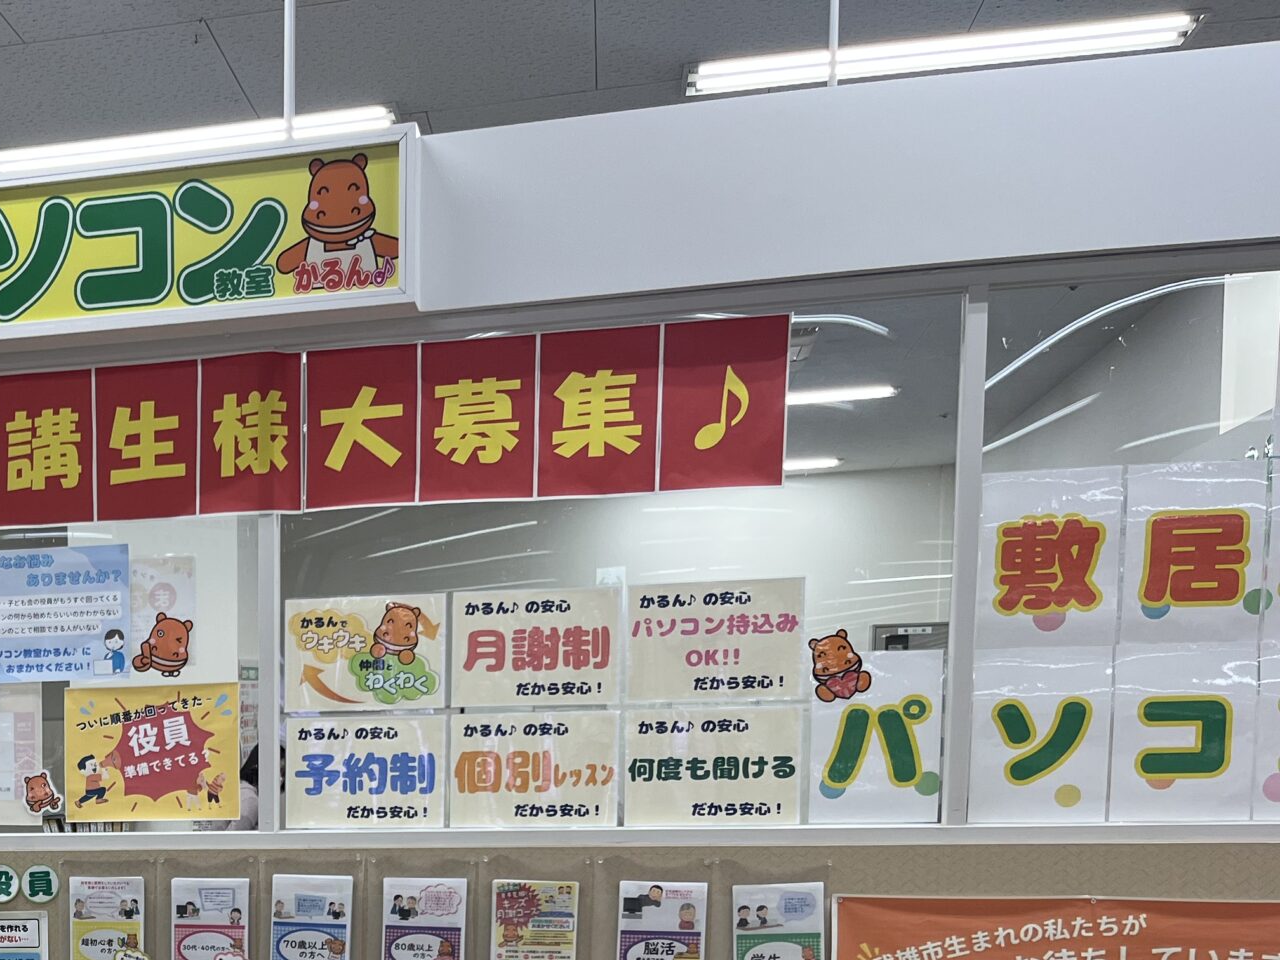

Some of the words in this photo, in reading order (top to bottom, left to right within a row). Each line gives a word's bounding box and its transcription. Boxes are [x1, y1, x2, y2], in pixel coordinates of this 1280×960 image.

[300, 617, 347, 629] かるんで
[632, 613, 799, 638] パソコン持込み
[301, 630, 367, 654] ウキウキ
[463, 626, 611, 672] 月謝制
[359, 660, 392, 671] 仲間と
[685, 648, 740, 667] OK!!
[365, 672, 429, 694] わくわく
[516, 681, 602, 696] だから安心!
[694, 675, 784, 691] だから安心!
[127, 716, 192, 757] 役員
[295, 752, 436, 796] 予約制
[628, 756, 796, 783] 何度も聞ける
[347, 806, 428, 819] だから安心!
[514, 804, 600, 818] だから安心!
[692, 803, 781, 816] だから安心!
[394, 943, 433, 952] 80歳以上
[644, 942, 675, 955] 脳活
